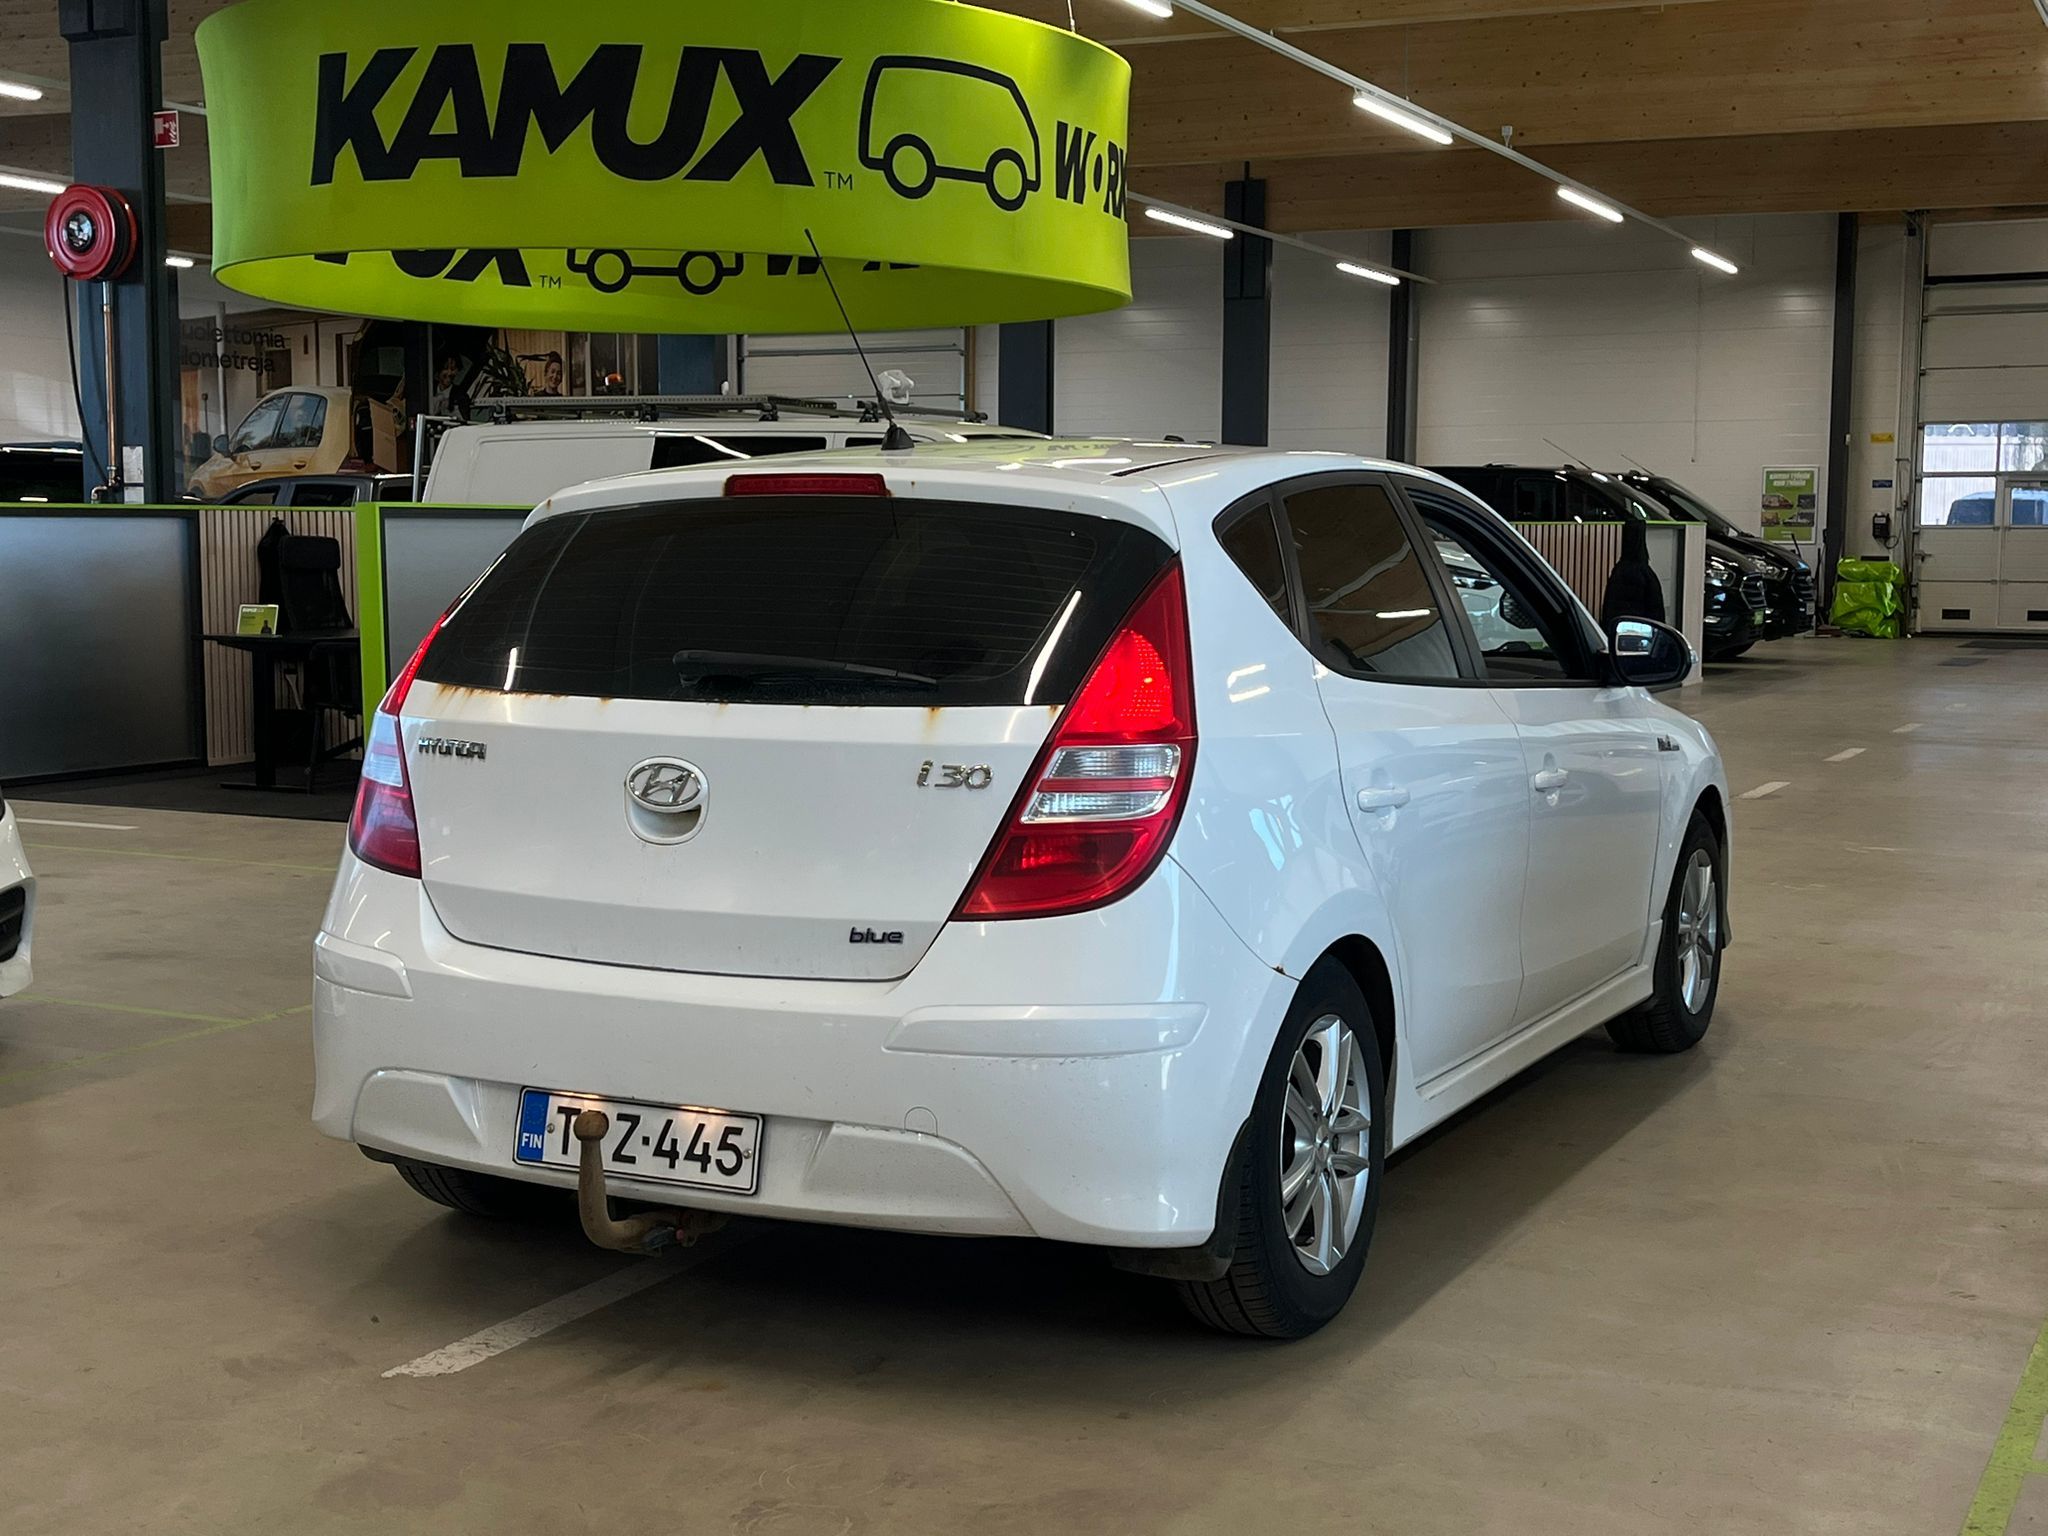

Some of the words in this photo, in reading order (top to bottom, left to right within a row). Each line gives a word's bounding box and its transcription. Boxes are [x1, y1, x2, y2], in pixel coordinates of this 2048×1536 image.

[310, 43, 842, 187] KAMUX
[823, 171, 853, 191] TM
[539, 275, 562, 289] TM
[849, 926, 904, 944] blue
[521, 1132, 542, 1149] FIN
[556, 1106, 744, 1177] TZ-445
